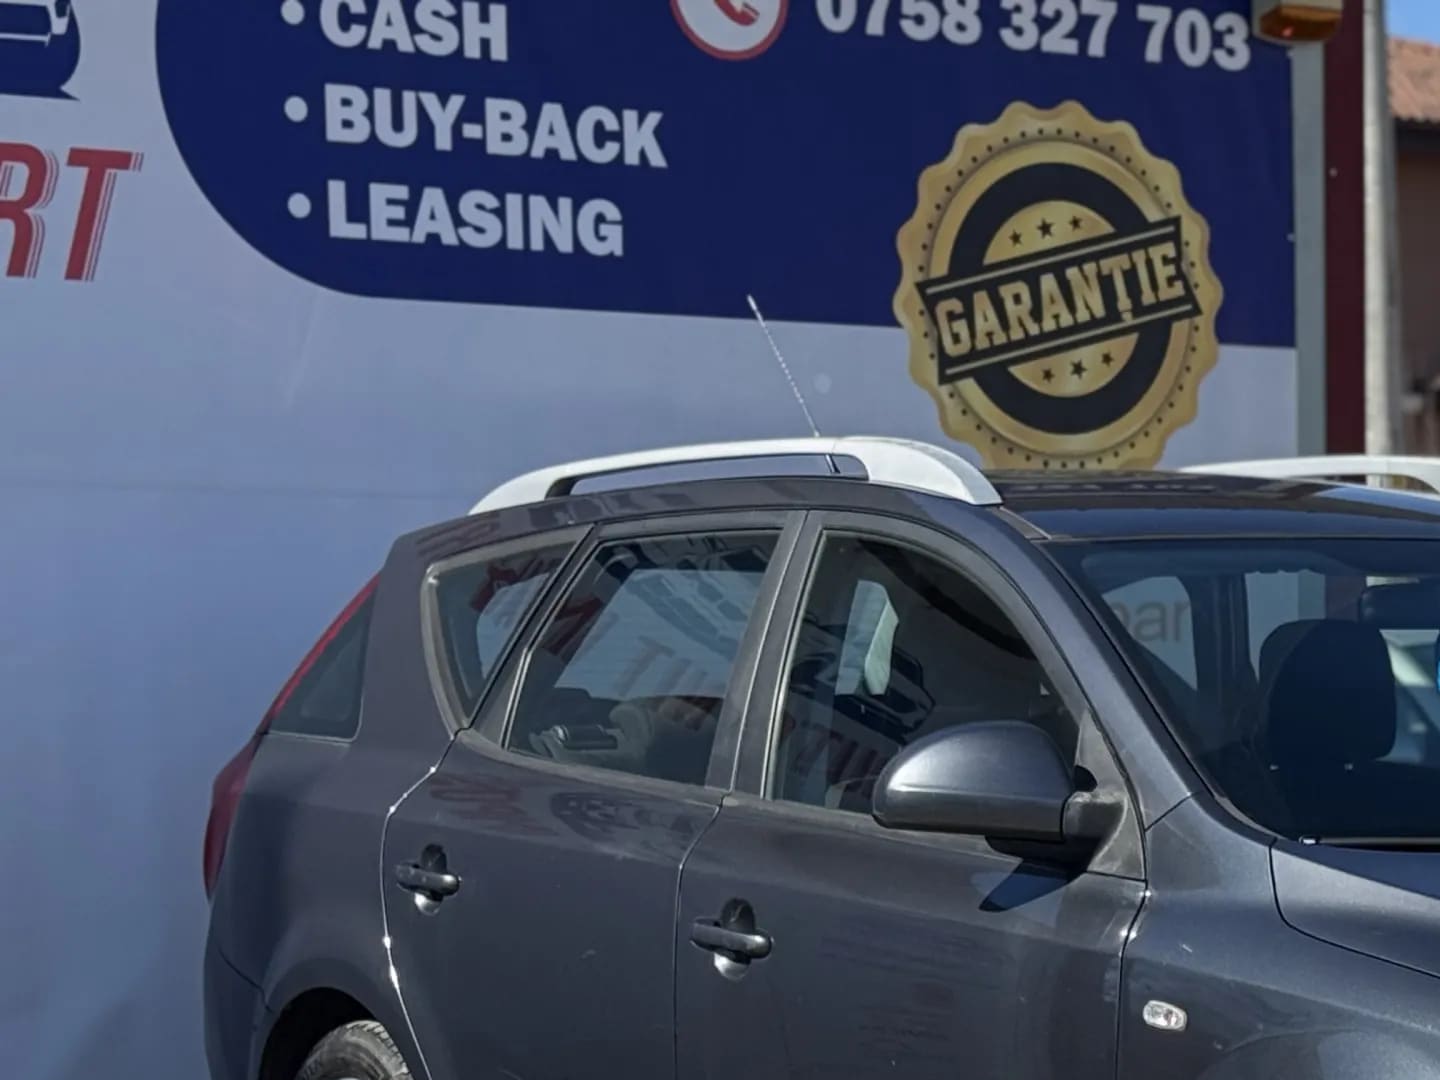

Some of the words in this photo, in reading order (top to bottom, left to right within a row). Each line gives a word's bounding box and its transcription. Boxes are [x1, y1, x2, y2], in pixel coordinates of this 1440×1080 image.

[319, 0, 508, 62] CASH
[815, 0, 983, 45] 0758
[998, 0, 1117, 57] 327
[1136, 4, 1251, 71] 703
[324, 83, 668, 168] BUY-BACK
[327, 179, 624, 257] LEASING
